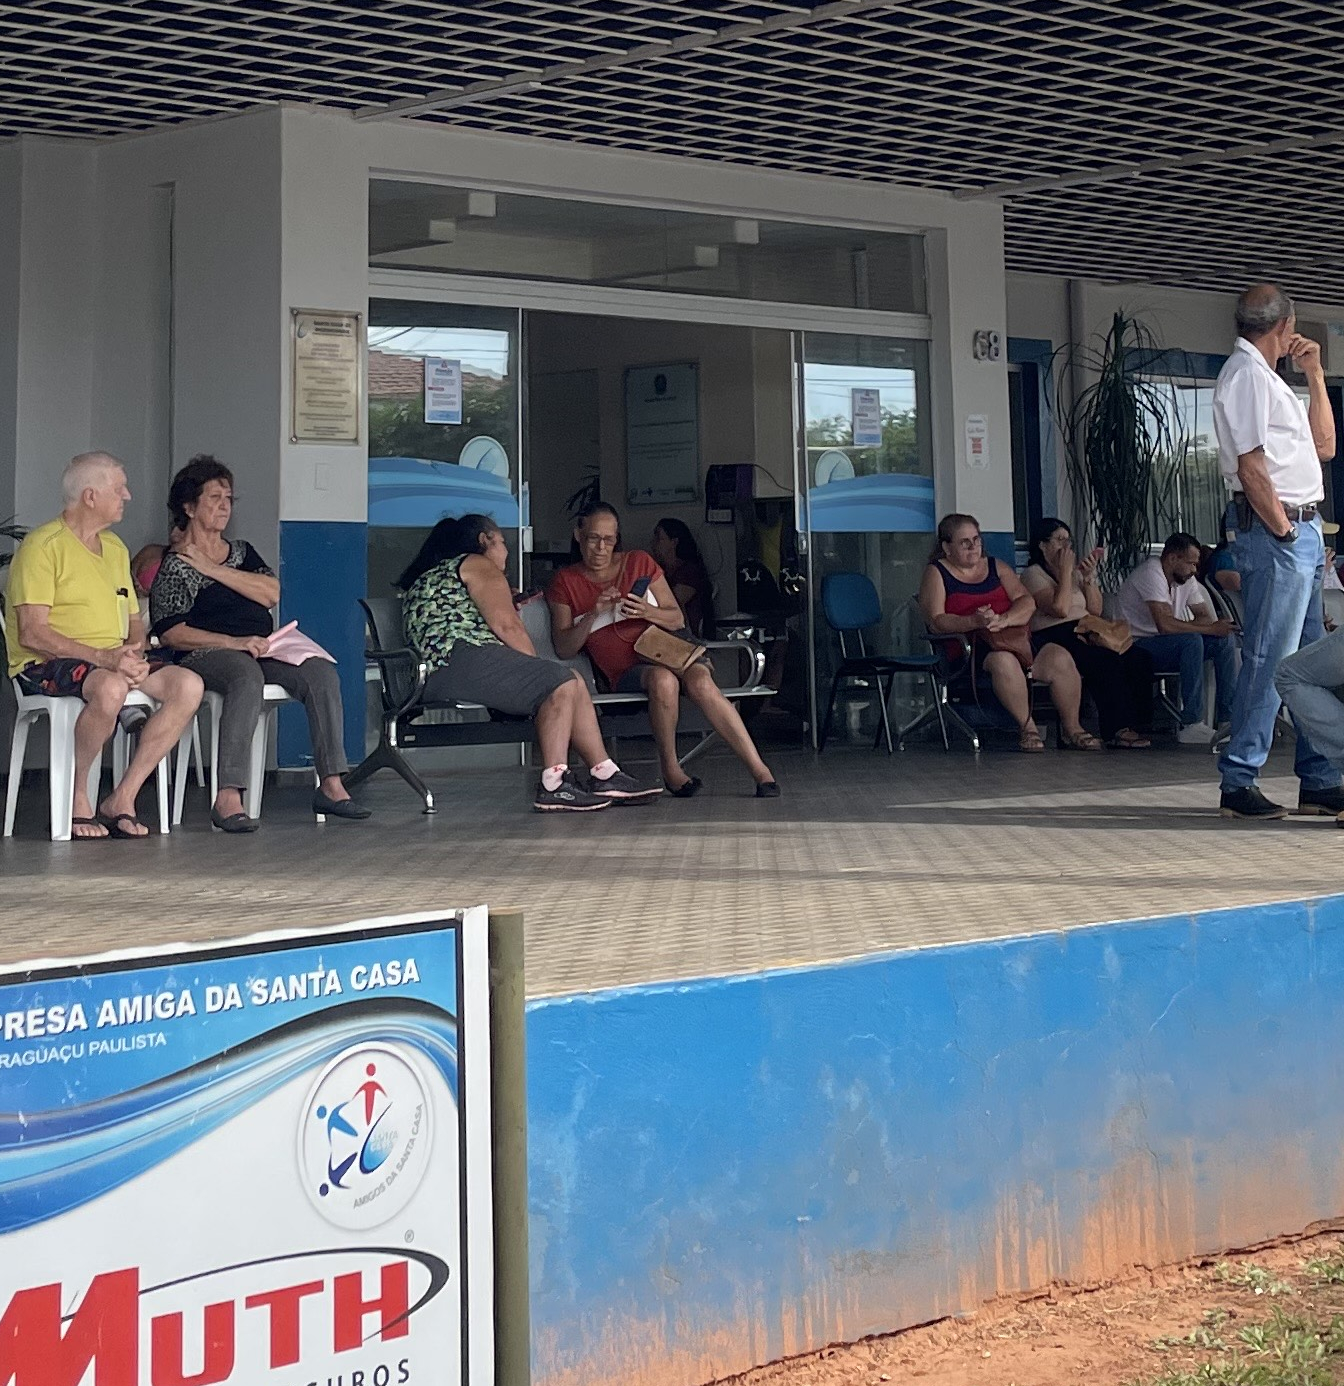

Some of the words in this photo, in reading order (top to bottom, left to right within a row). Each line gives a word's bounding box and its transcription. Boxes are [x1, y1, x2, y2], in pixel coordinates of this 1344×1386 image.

[96, 989, 197, 1028] AMIGA
[205, 982, 244, 1014] DA
[251, 968, 343, 1006] SANTA
[350, 958, 421, 991] CASA
[88, 1031, 167, 1057] PAULISTA
[353, 1182, 386, 1209] AMIGOS
[385, 1172, 398, 1187] DA
[396, 1137, 416, 1172] SANTA
[412, 1102, 424, 1136] CASA
